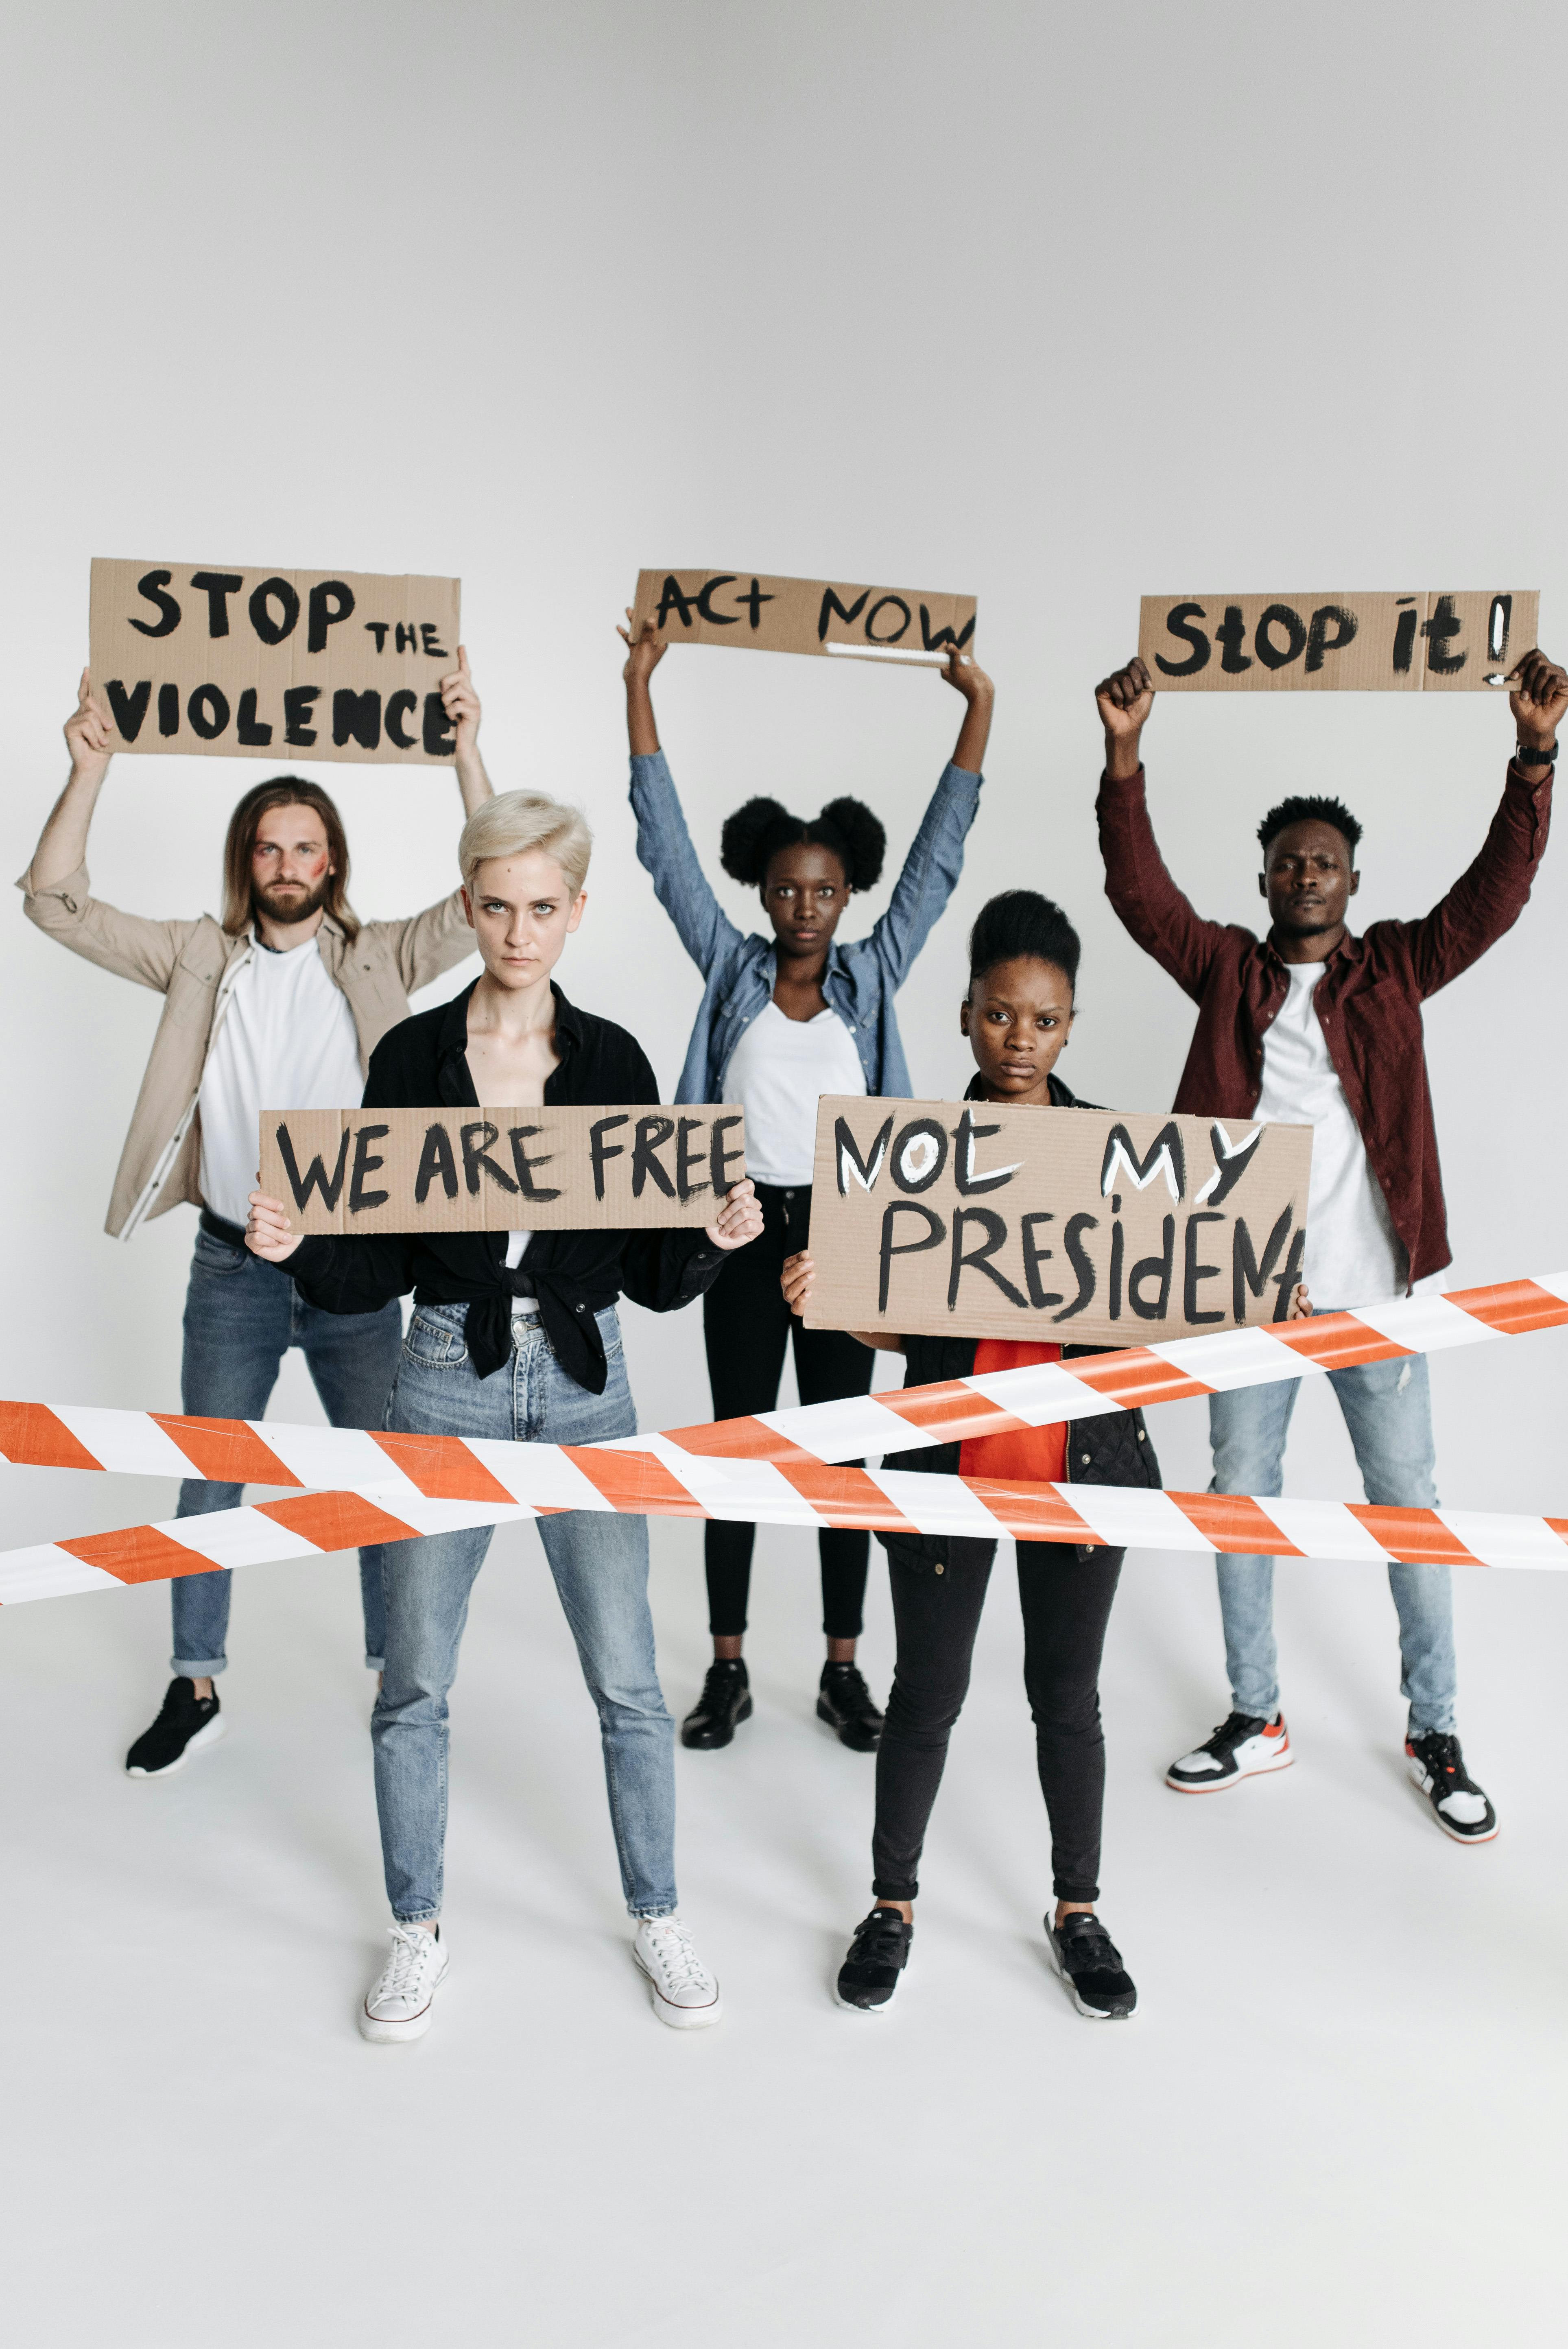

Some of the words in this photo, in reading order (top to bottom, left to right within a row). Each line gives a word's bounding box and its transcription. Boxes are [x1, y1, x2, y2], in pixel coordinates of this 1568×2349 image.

[127, 569, 357, 654] STOP
[363, 621, 449, 658] THE
[817, 588, 976, 651] NOW
[103, 679, 458, 757] VIOLENCE
[275, 1120, 391, 1215] WE
[414, 1120, 568, 1206] ARE
[589, 1114, 745, 1207] FREE
[1100, 1120, 1268, 1207] MY
